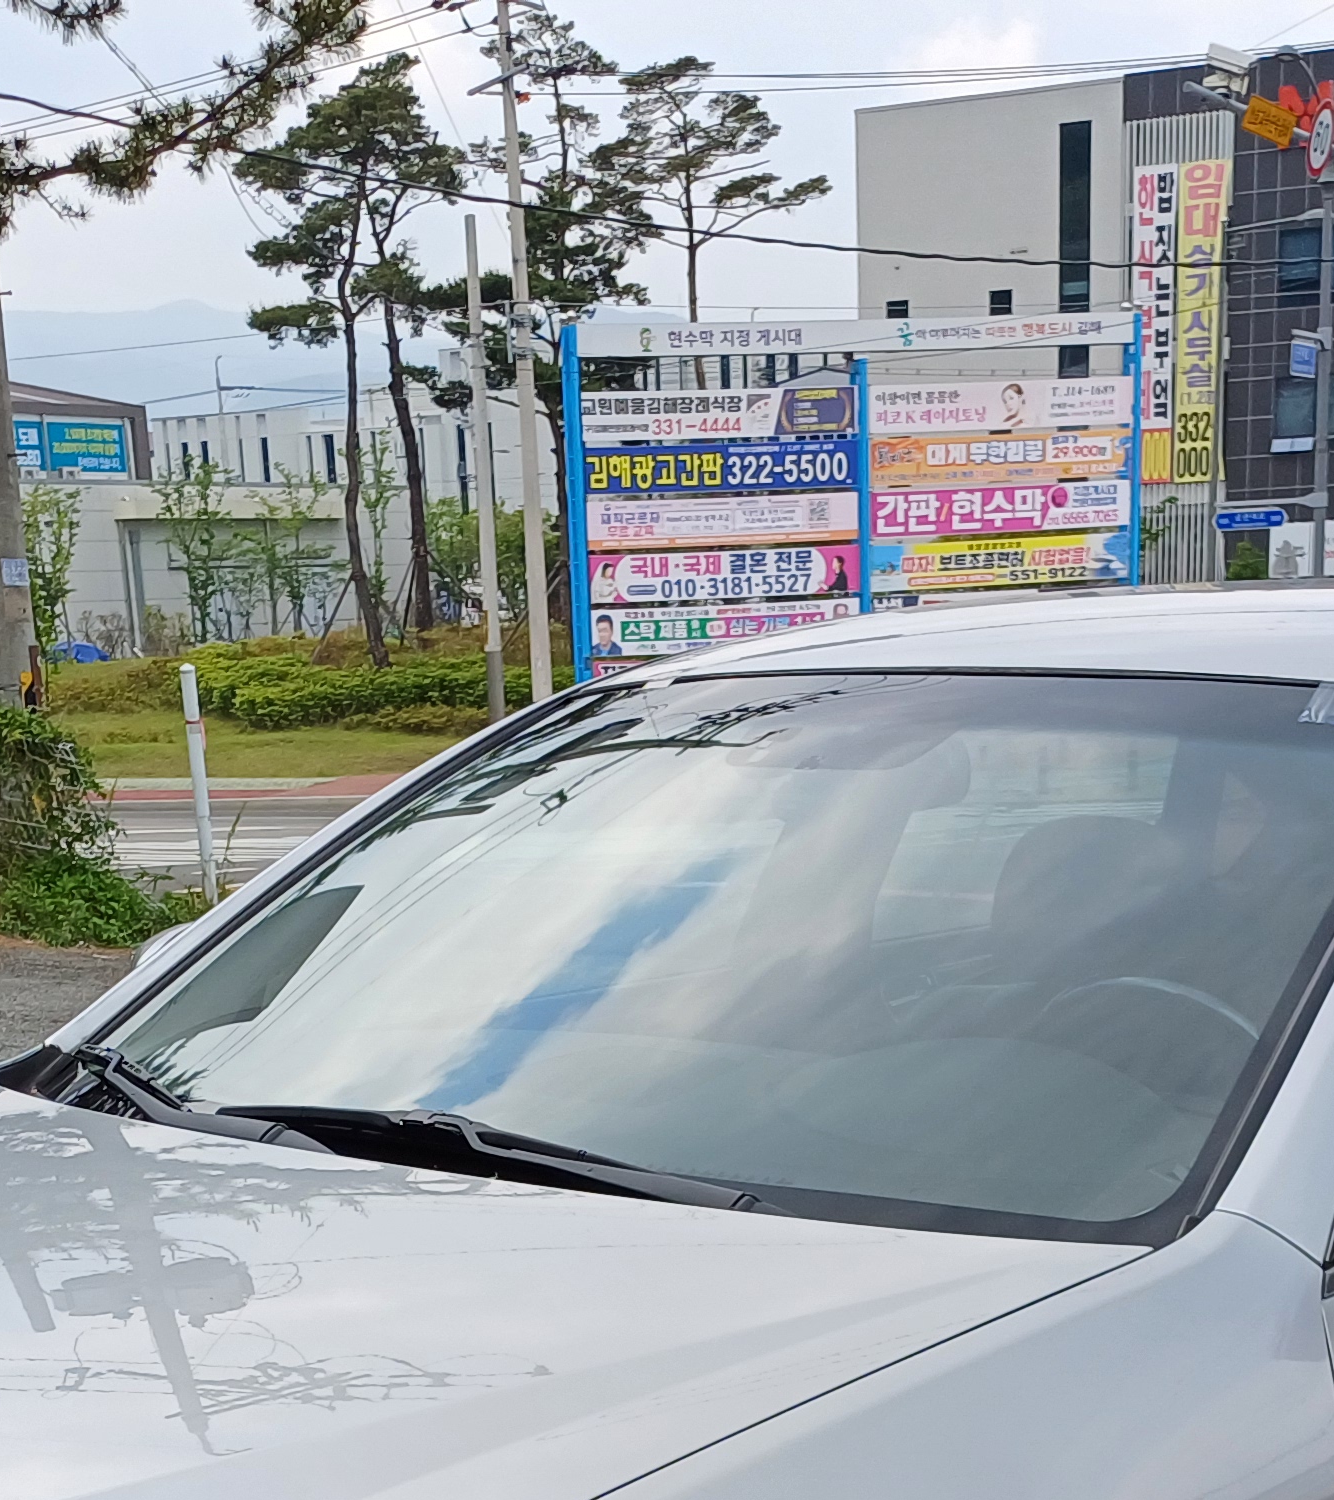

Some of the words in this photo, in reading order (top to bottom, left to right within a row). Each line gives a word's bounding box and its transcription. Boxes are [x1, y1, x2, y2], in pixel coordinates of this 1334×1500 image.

[1183, 162, 1225, 238] 임대
[667, 329, 714, 348] 현수막
[720, 328, 750, 347] 지정
[756, 328, 803, 347] 게시대
[651, 417, 742, 436] 331-4444
[969, 440, 1043, 465] 무한리필
[586, 452, 724, 489] 김해광고간판
[727, 452, 849, 485] 322-5500
[729, 552, 768, 575] 결혼
[773, 550, 814, 572] 전문
[1009, 565, 1087, 581] 551-9122
